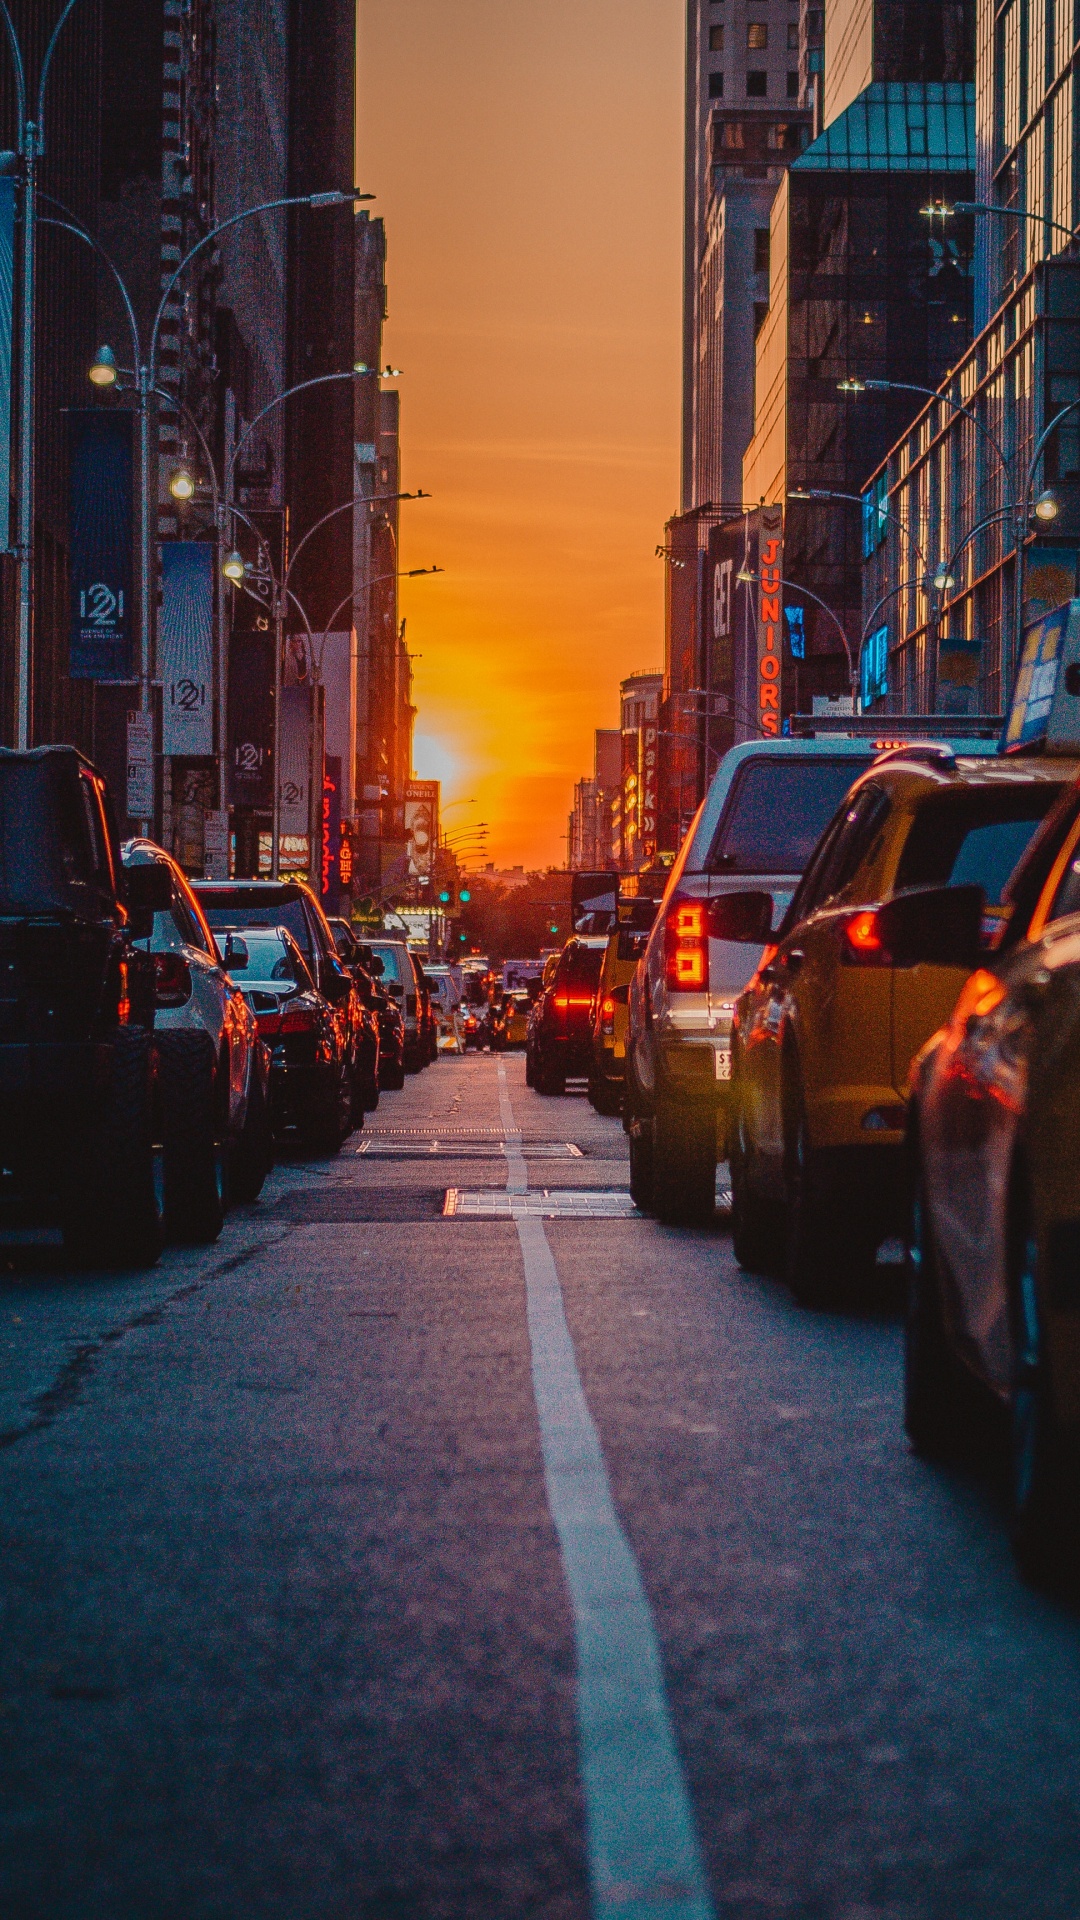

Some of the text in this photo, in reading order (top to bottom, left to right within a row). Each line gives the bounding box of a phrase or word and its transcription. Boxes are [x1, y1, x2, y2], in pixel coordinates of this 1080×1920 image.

[80, 582, 124, 625] 1221
[759, 539, 781, 737] JUNIORS
[171, 678, 205, 711] 1221
